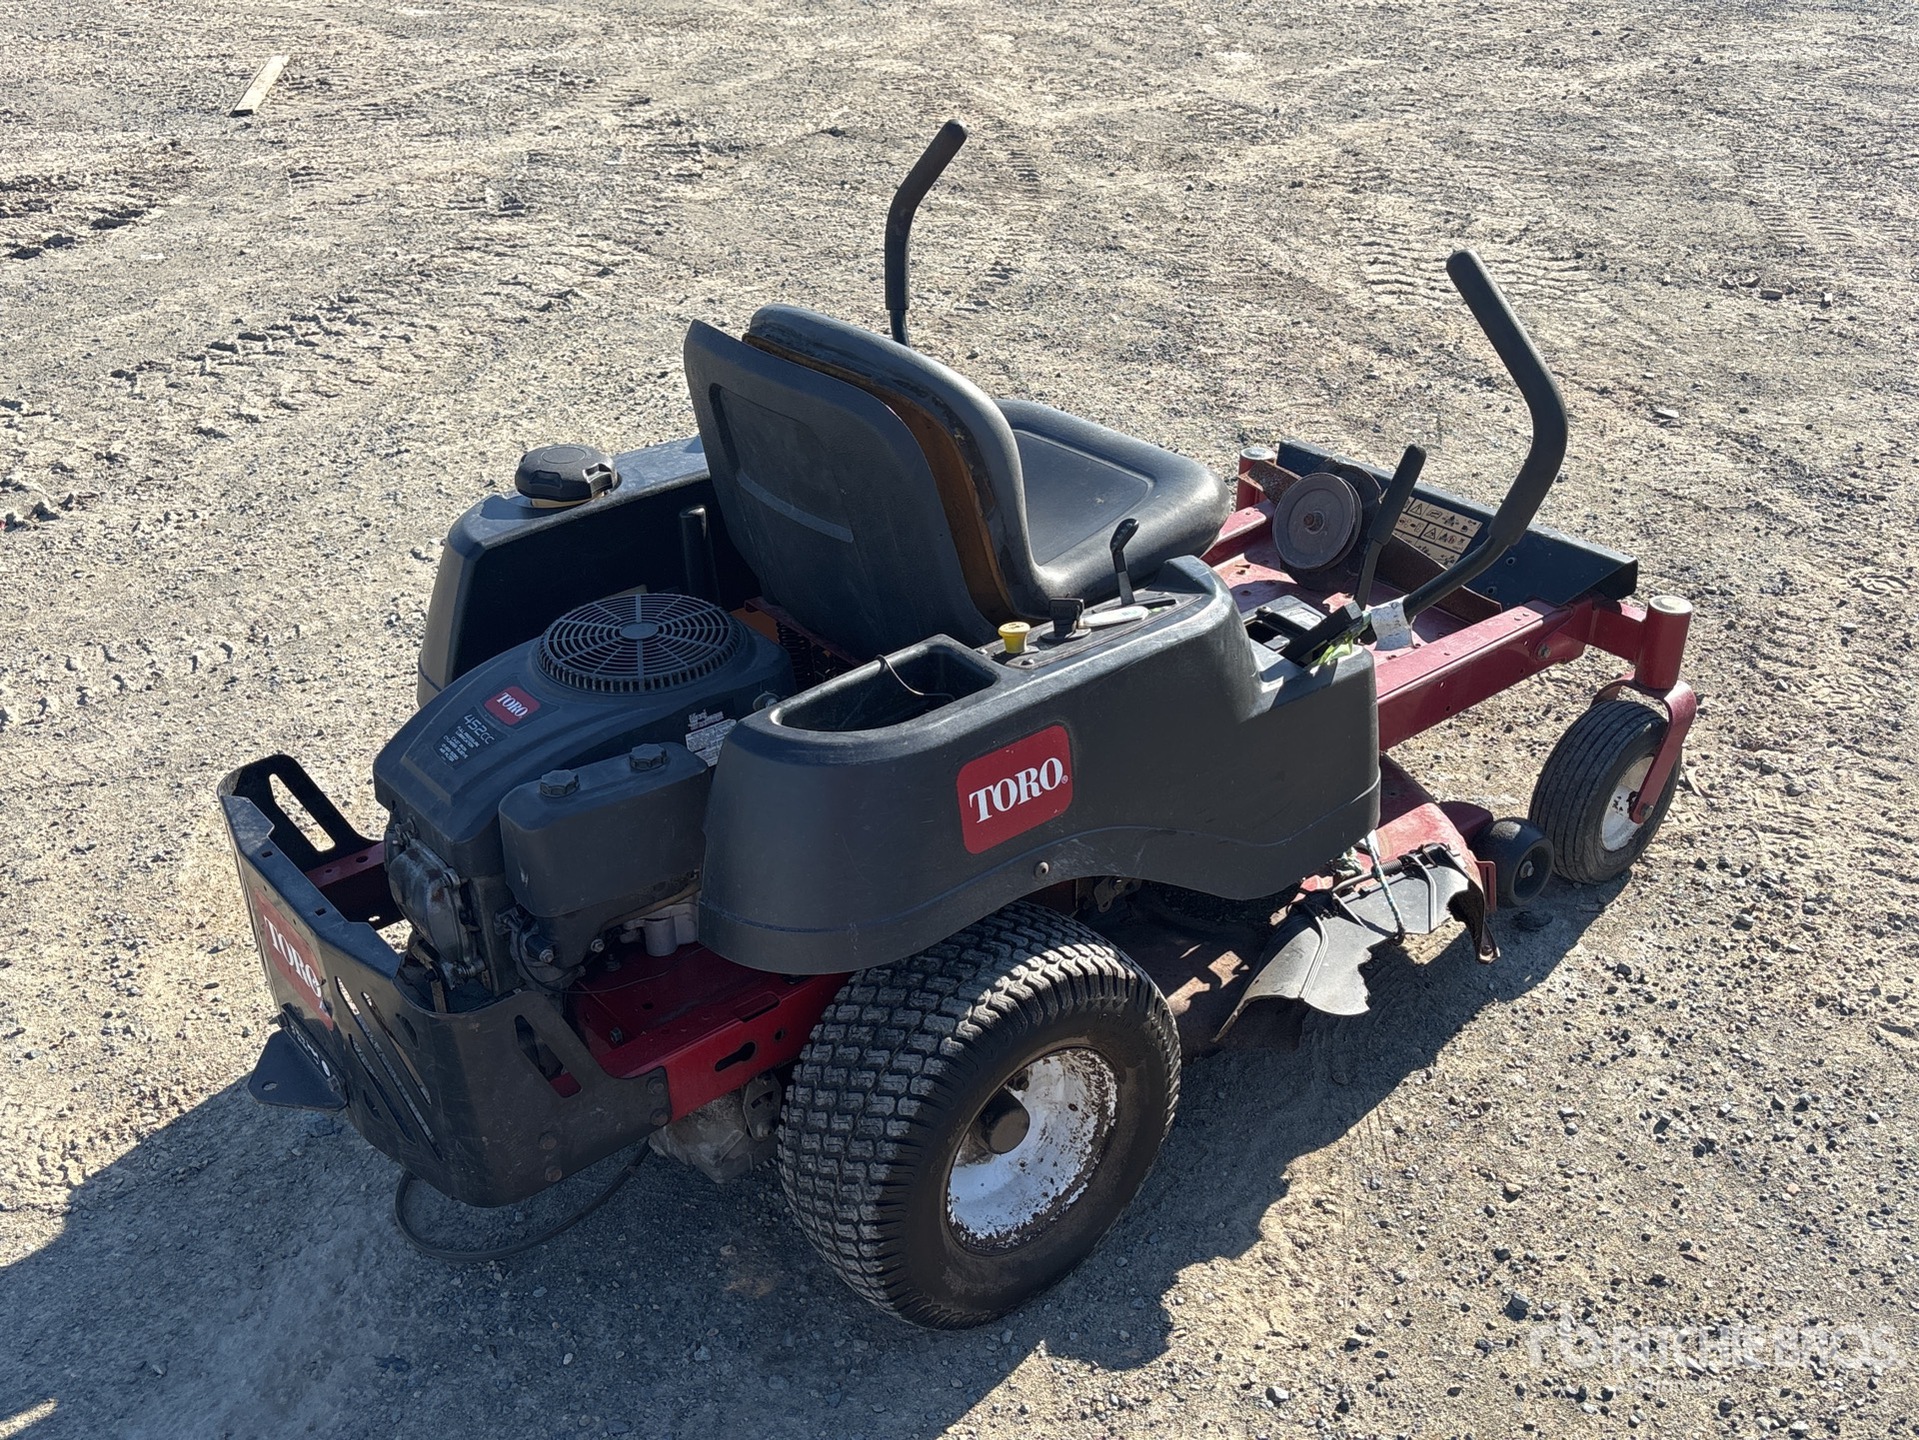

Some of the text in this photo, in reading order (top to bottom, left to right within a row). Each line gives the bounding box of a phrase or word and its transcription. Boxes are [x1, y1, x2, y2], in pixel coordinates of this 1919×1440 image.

[496, 692, 528, 717] TORO
[968, 757, 1064, 823] TORO
[264, 915, 322, 998] TORO
